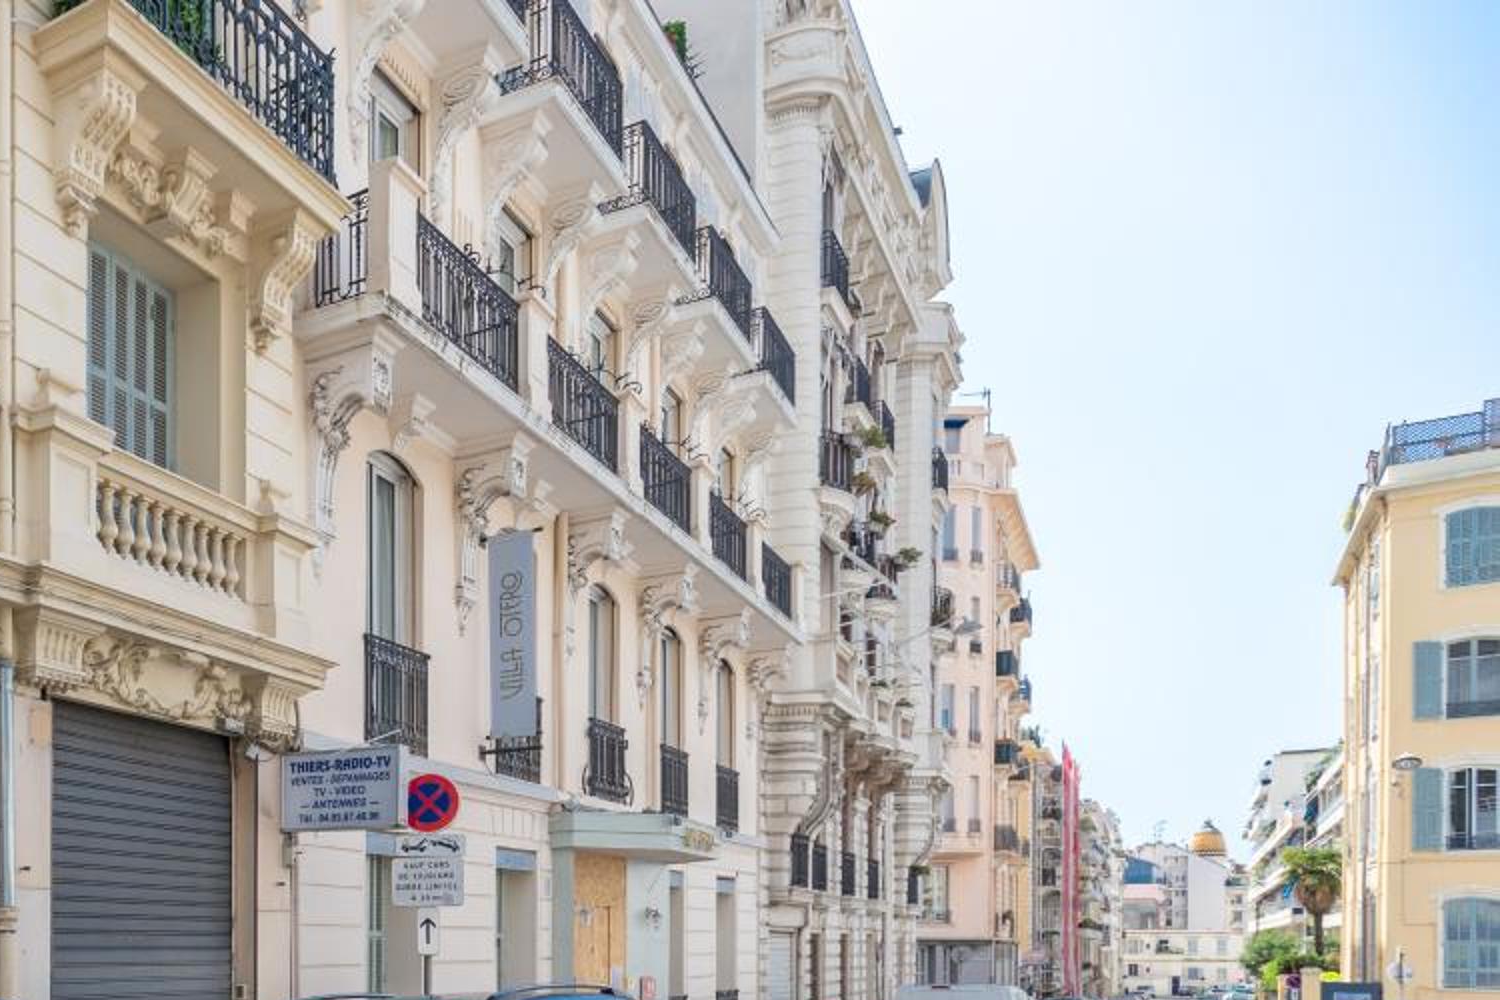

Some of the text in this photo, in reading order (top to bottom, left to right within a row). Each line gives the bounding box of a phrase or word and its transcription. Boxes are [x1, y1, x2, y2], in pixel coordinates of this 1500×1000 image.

[499, 569, 525, 701] VILLA OTERO
[290, 755, 392, 774] THIERS-RADIO-TV
[313, 787, 327, 797] TV
[311, 798, 367, 810] ANTENNES
